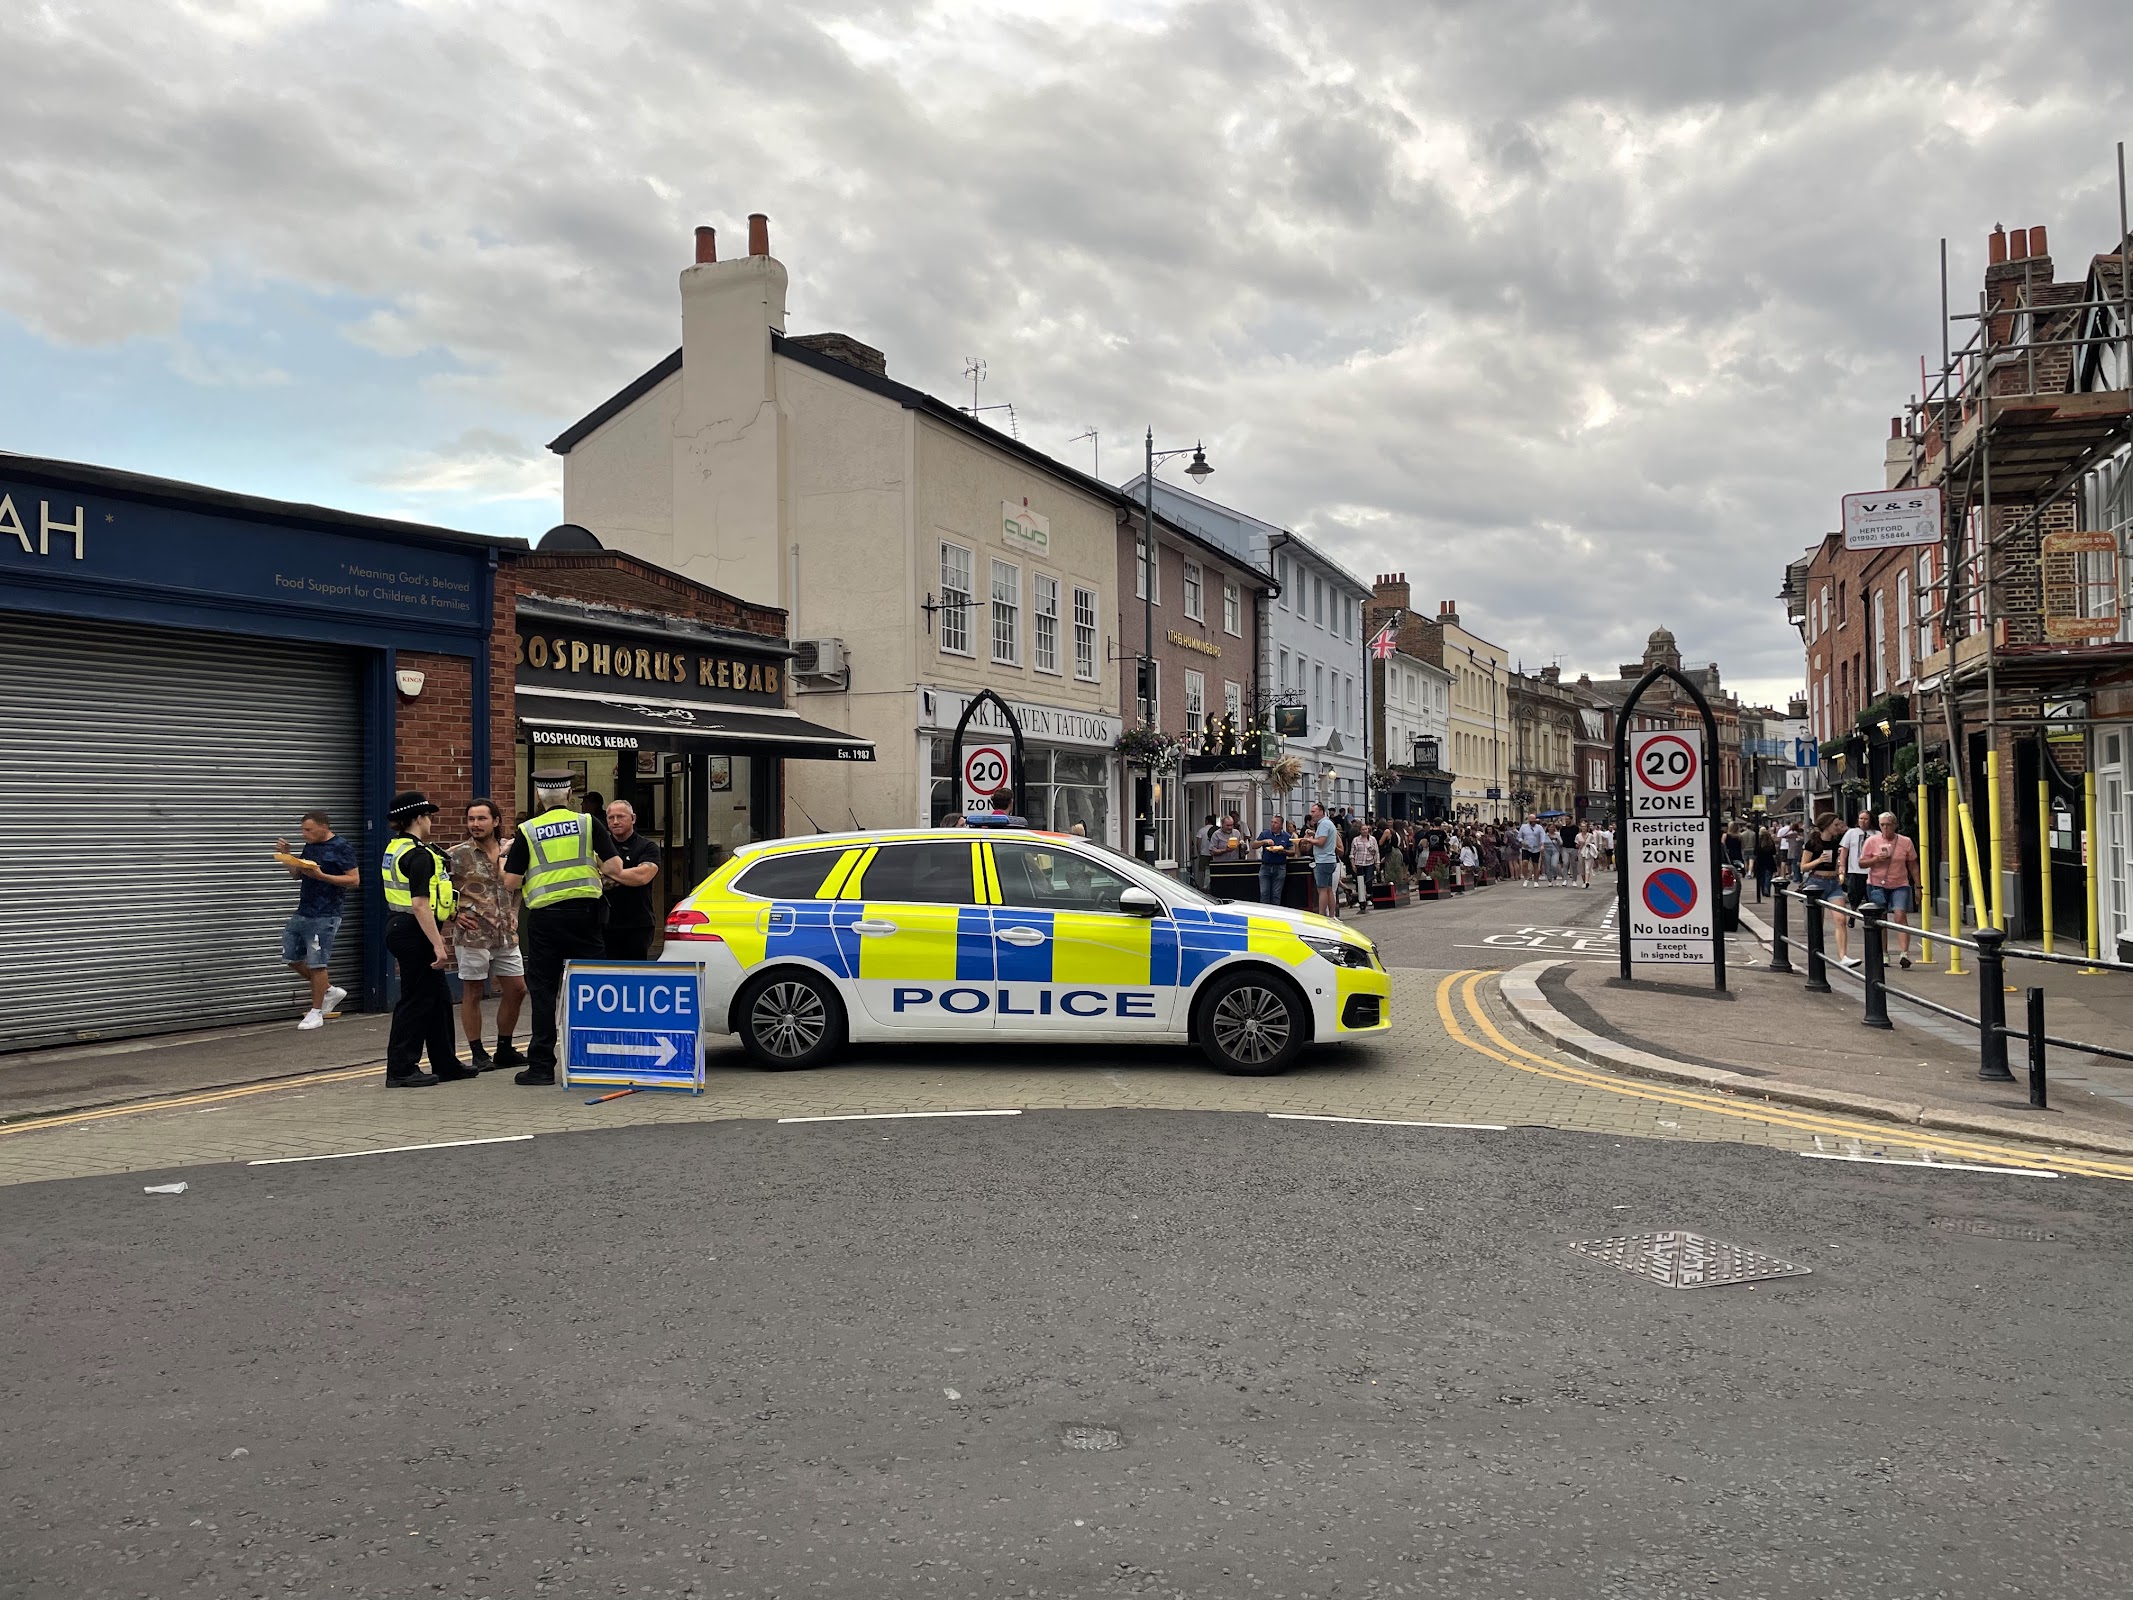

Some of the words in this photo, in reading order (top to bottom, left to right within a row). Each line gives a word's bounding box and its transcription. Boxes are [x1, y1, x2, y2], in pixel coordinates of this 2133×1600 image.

[1862, 504, 1878, 512] V
[1908, 500, 1923, 508] S
[1849, 534, 1877, 543] (01992)
[1880, 532, 1910, 540] 558464
[1860, 525, 1902, 534] HERTFORD
[349, 564, 395, 583] Meaning
[399, 571, 429, 586] God's
[432, 575, 470, 592] Beloved
[275, 573, 303, 589] Food
[308, 578, 351, 595] Support
[355, 584, 369, 598] for
[373, 587, 417, 604] Children
[420, 594, 427, 604] &
[431, 595, 470, 611] Families
[699, 656, 779, 694] KEBAB
[1054, 712, 1107, 742] TATTOOS
[532, 731, 602, 747] BOSPHORUS
[603, 736, 639, 749] KEBAB
[852, 749, 870, 760] 1987
[972, 761, 1003, 781] 20
[1646, 751, 1689, 775] 20
[967, 799, 995, 811] ZON
[1639, 795, 1695, 811] ZONE
[536, 821, 578, 839] POLICE
[1632, 821, 1705, 833] Restricted
[1642, 836, 1694, 848] parking
[1642, 850, 1695, 863] ZONE
[1634, 923, 1653, 934] No
[1658, 924, 1709, 937] loading
[1483, 934, 1616, 952] CLE
[1656, 942, 1687, 951] Except
[1651, 952, 1680, 960] signed
[1683, 952, 1703, 960] bays
[577, 984, 692, 1015] POLICE
[892, 987, 1157, 1018] POLICE
